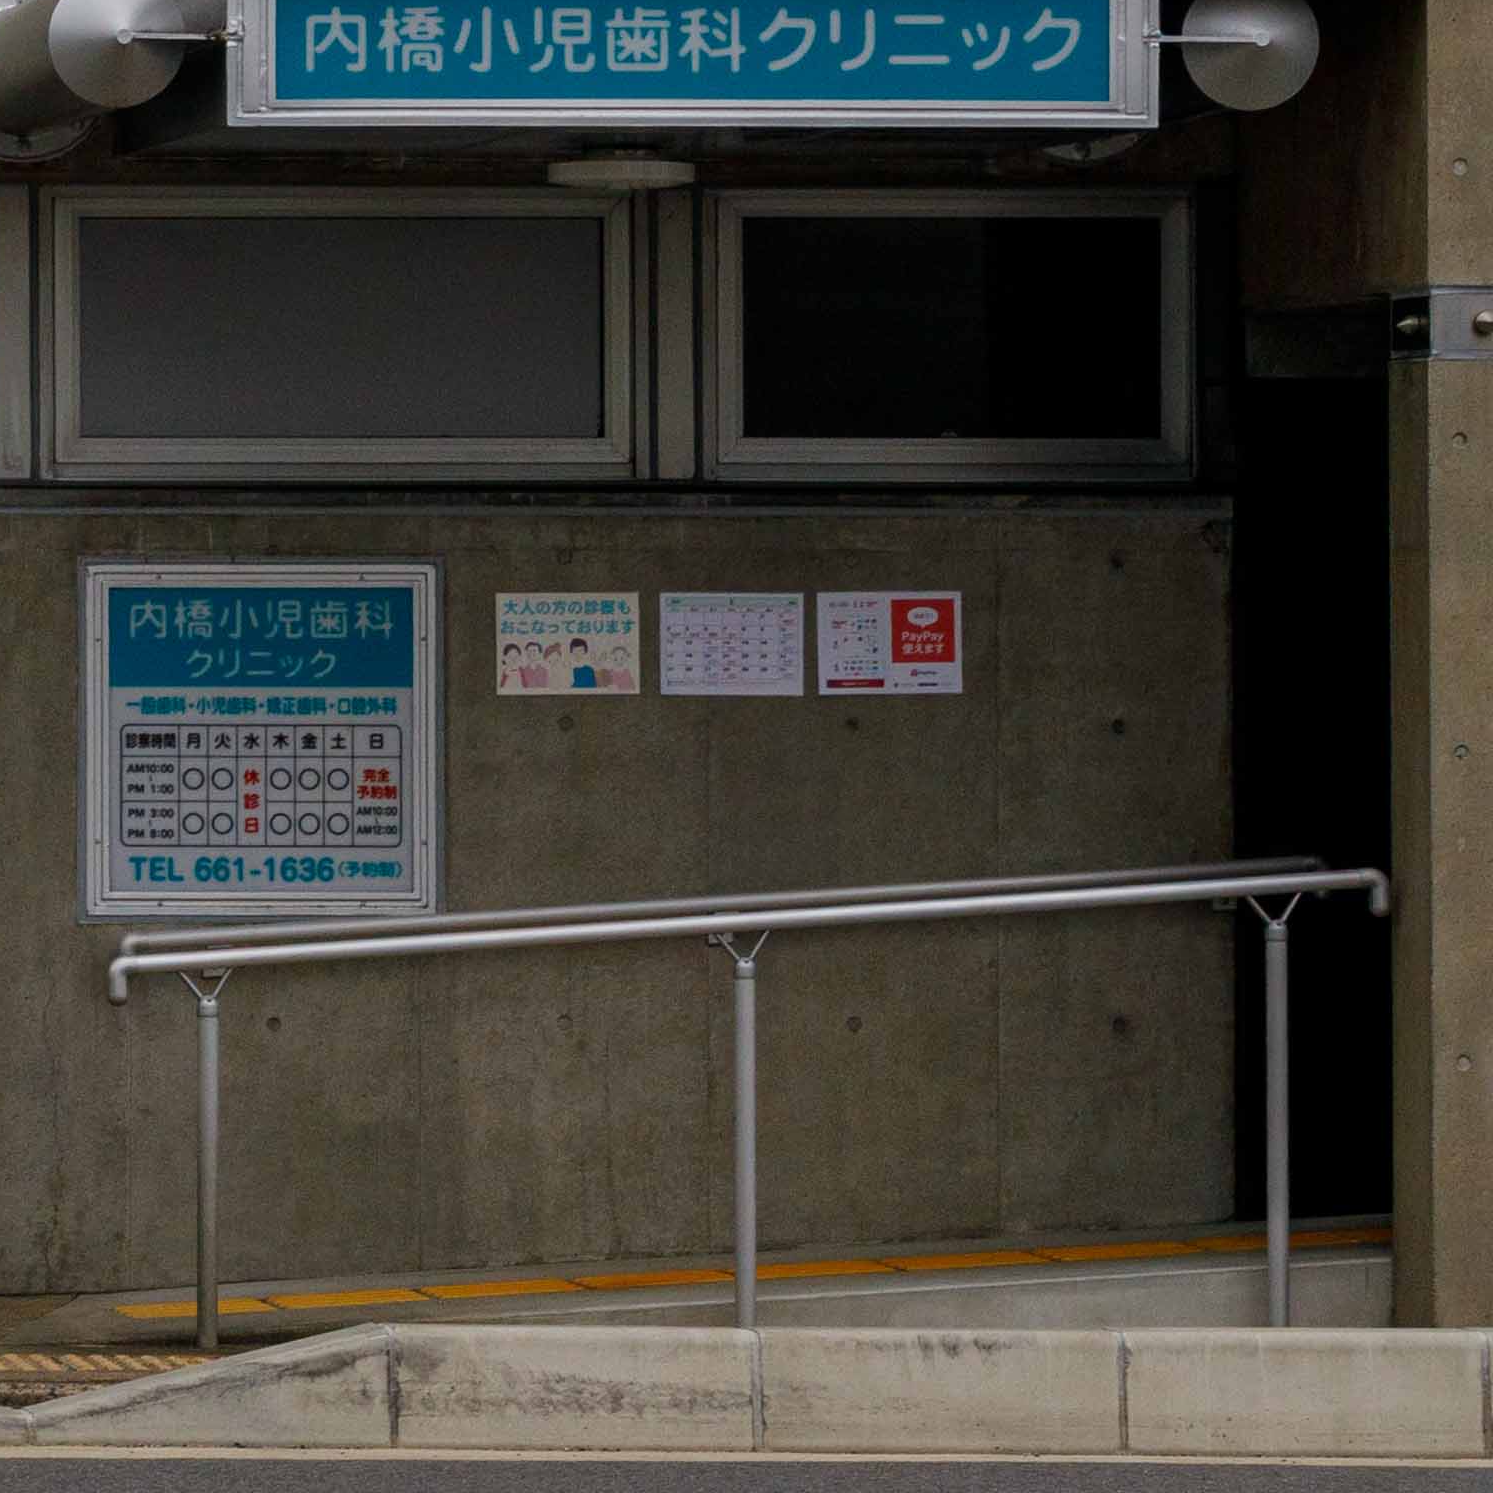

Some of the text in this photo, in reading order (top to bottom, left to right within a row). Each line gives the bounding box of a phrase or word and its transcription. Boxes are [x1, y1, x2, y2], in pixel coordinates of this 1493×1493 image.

[303, 5, 1084, 75] 内橋小児歯科クリニック
[129, 599, 394, 640] 内橋小児歯科
[501, 619, 635, 634] おこなっております
[901, 631, 944, 643] PayPay
[186, 649, 337, 678] クリニック
[187, 733, 201, 749] 月
[214, 733, 231, 749] 火
[243, 733, 260, 749] 水
[272, 733, 290, 749] 木
[301, 733, 318, 749] 金
[330, 733, 347, 749] 土
[369, 733, 384, 749] 日
[127, 784, 144, 794] PM
[356, 785, 398, 799] 予約制
[243, 769, 261, 834] 休診日
[127, 809, 144, 818] PM
[127, 829, 144, 839] PM
[128, 857, 184, 882] TEL
[194, 857, 335, 882] 661-1636
